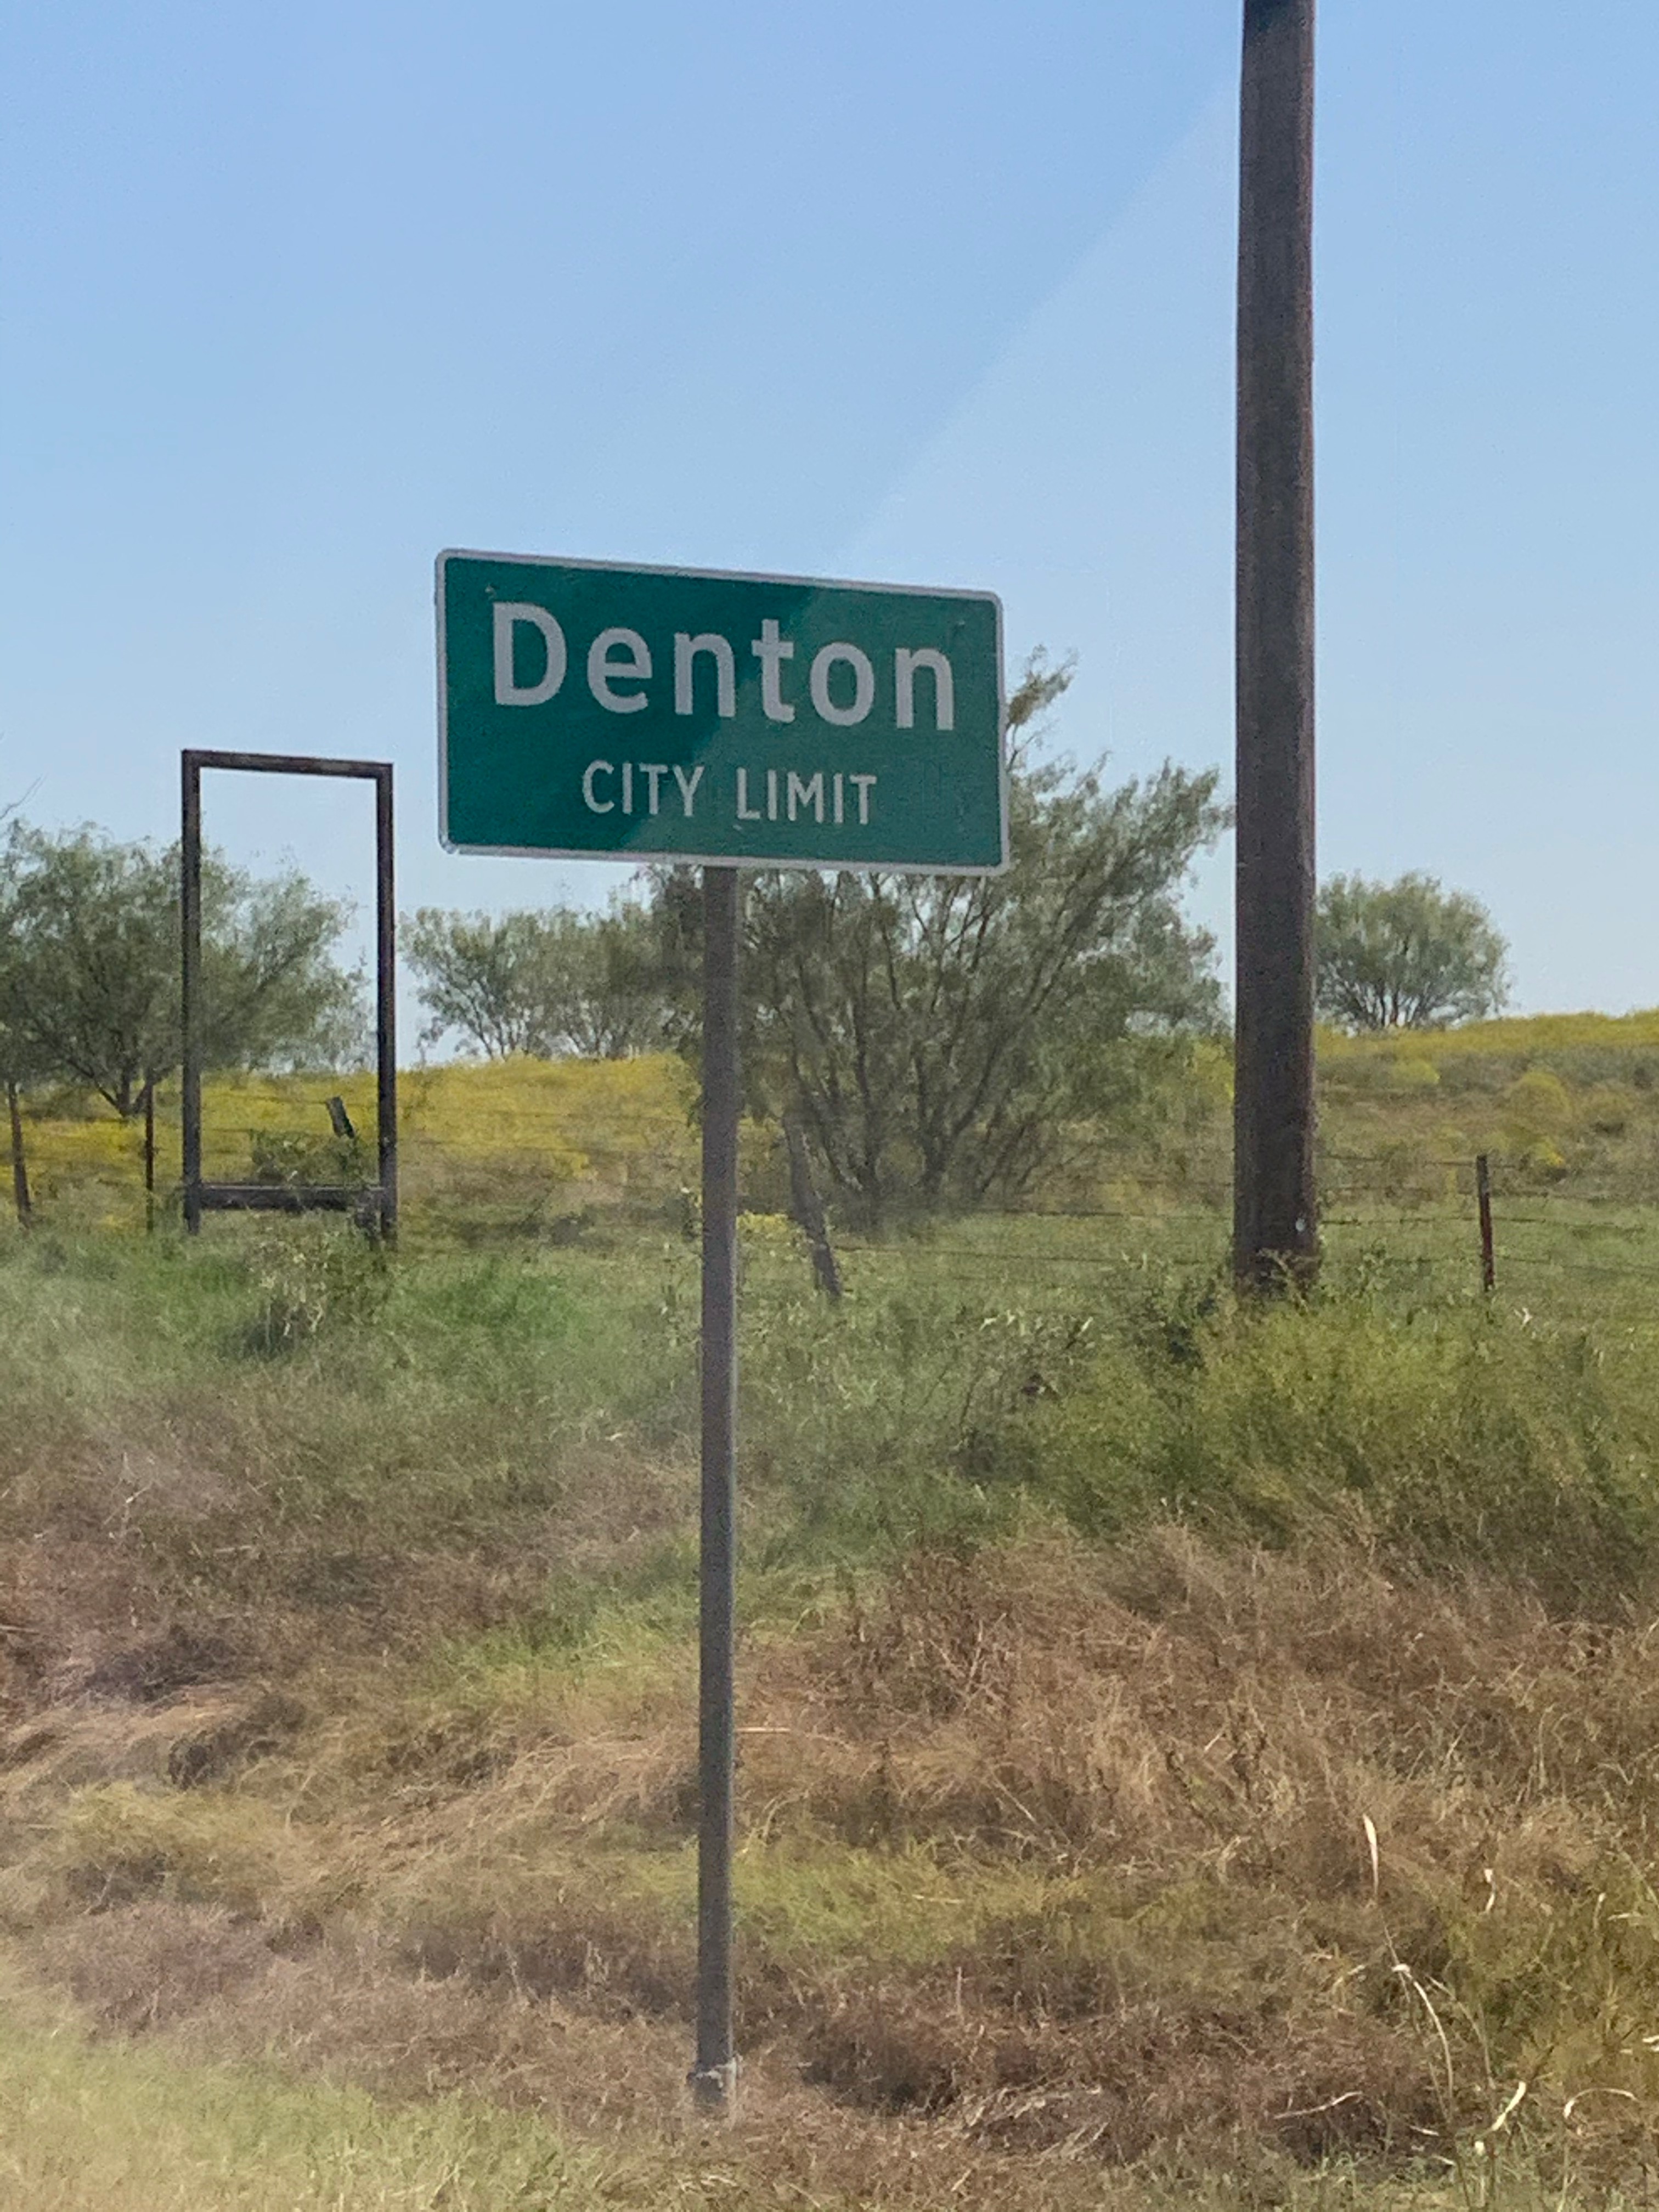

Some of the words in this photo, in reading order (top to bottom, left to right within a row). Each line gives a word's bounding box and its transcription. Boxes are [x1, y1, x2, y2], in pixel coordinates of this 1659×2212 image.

[492, 602, 955, 732] Denton
[582, 760, 705, 818] CITY
[736, 768, 878, 826] LIMIT
